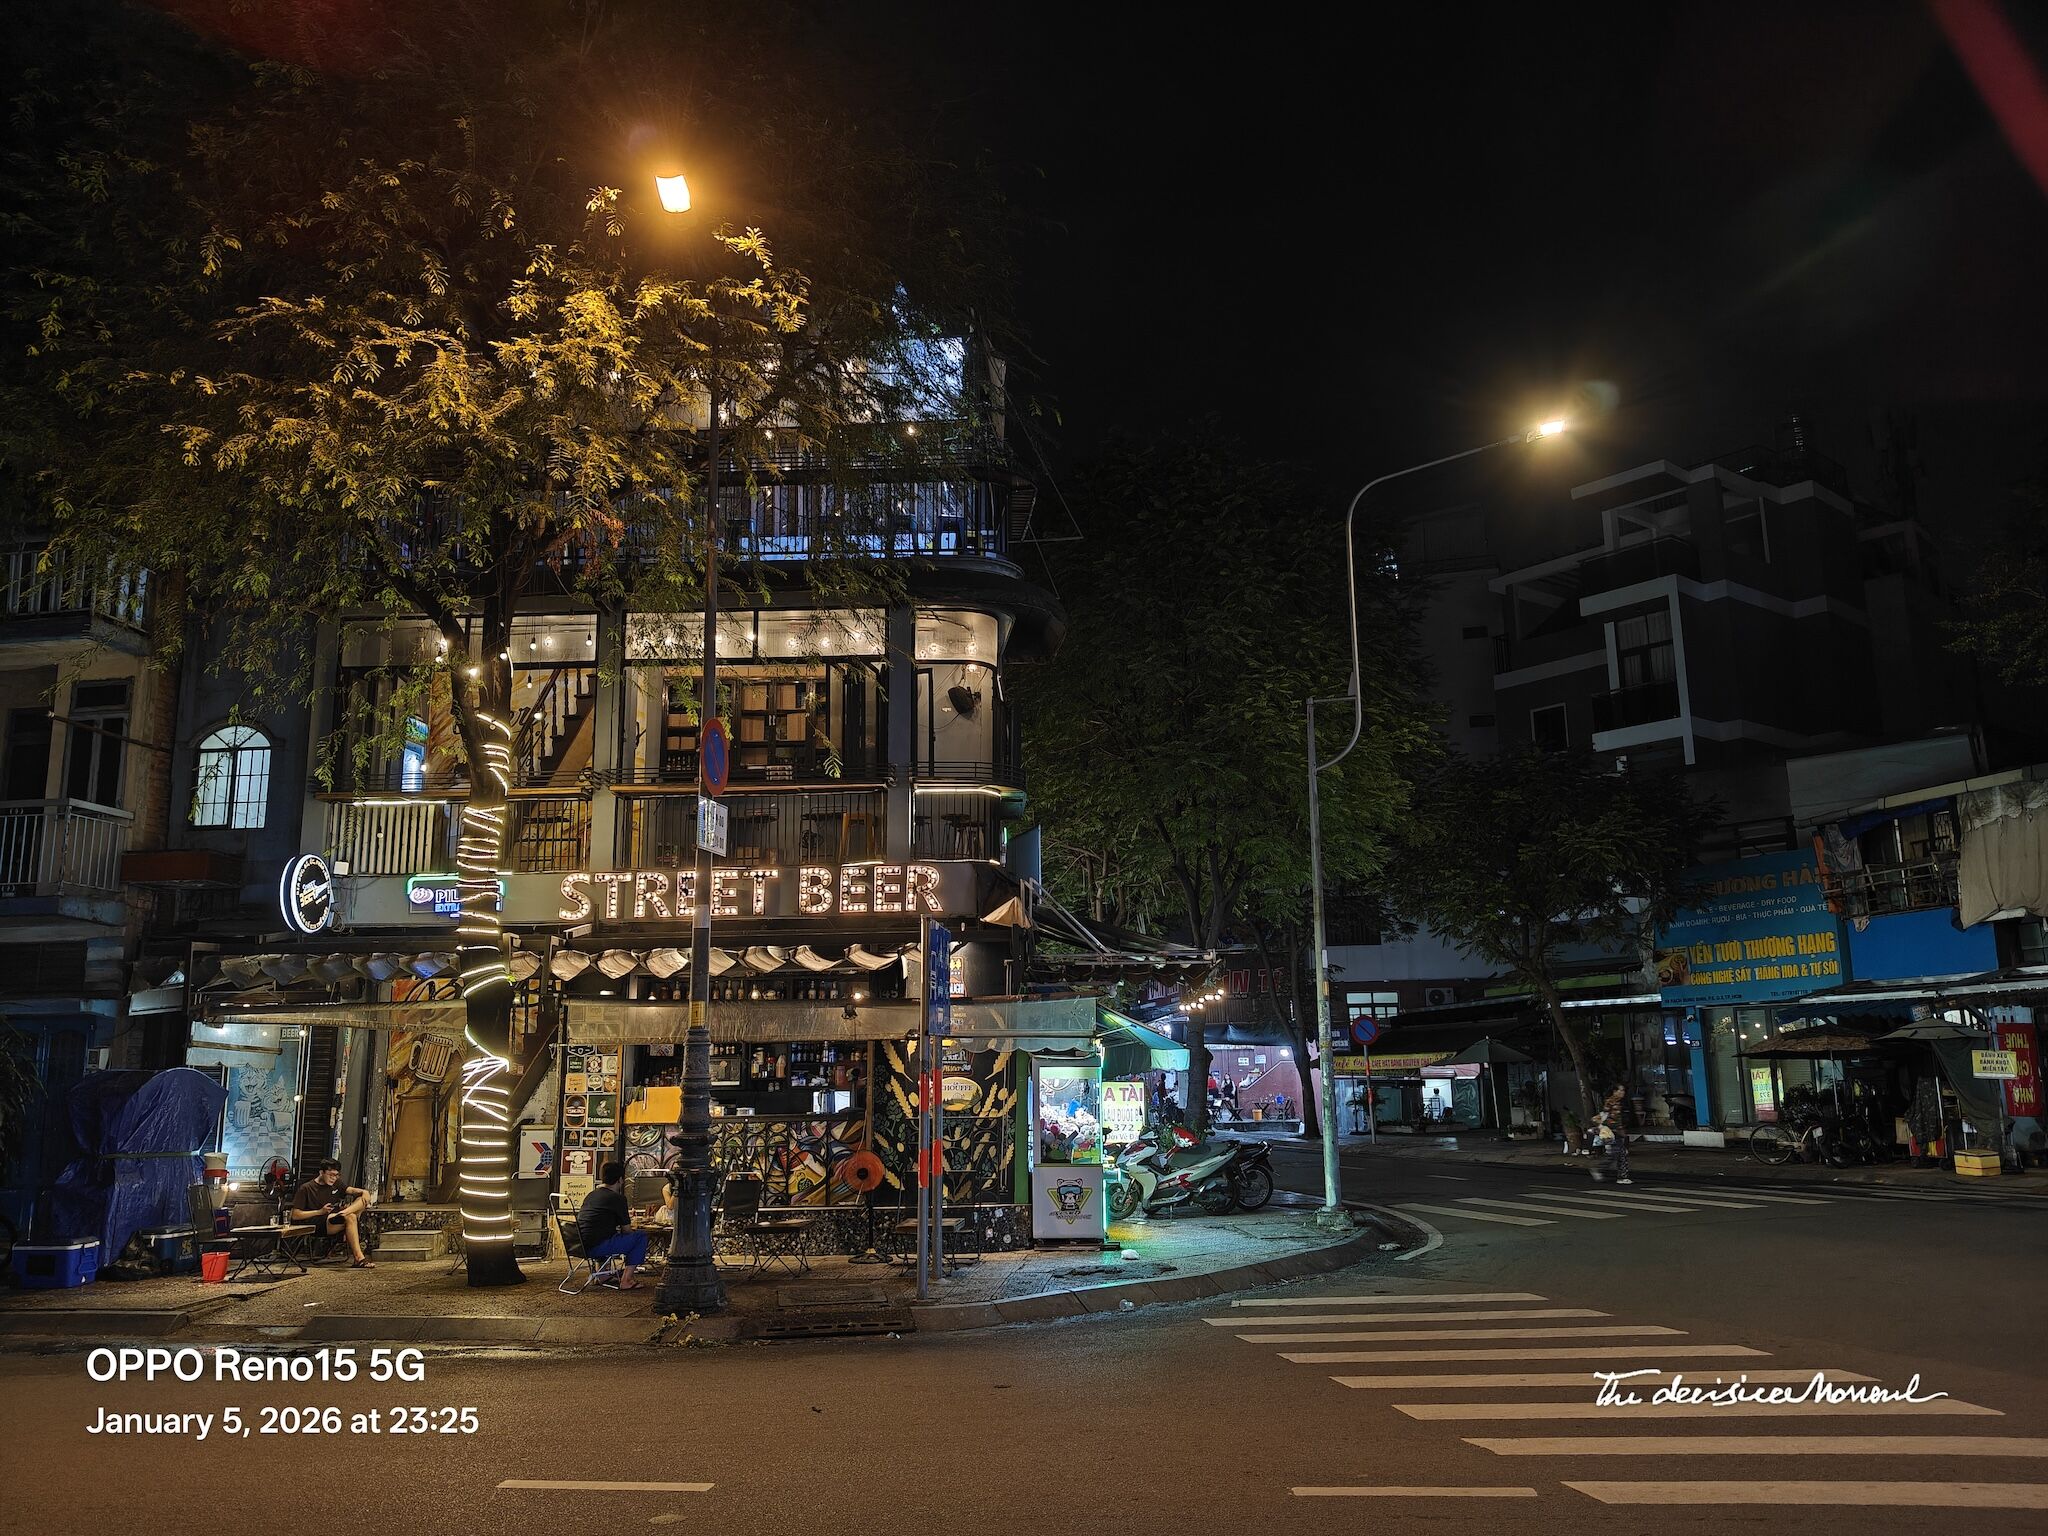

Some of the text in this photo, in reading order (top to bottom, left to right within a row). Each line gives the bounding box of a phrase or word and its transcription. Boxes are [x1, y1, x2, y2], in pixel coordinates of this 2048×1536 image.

[559, 865, 945, 921] STREET BEER
[1696, 895, 1797, 915] WE BEVERAGE DRY FOOD
[1735, 913, 1748, 921] BIA
[1797, 931, 1836, 959] HẠNG
[1781, 963, 1799, 978] HOA
[1801, 962, 1809, 976] &
[281, 1027, 300, 1038] BEER
[1103, 1083, 1143, 1102] A TÀI
[1114, 1123, 1134, 1132] 372
